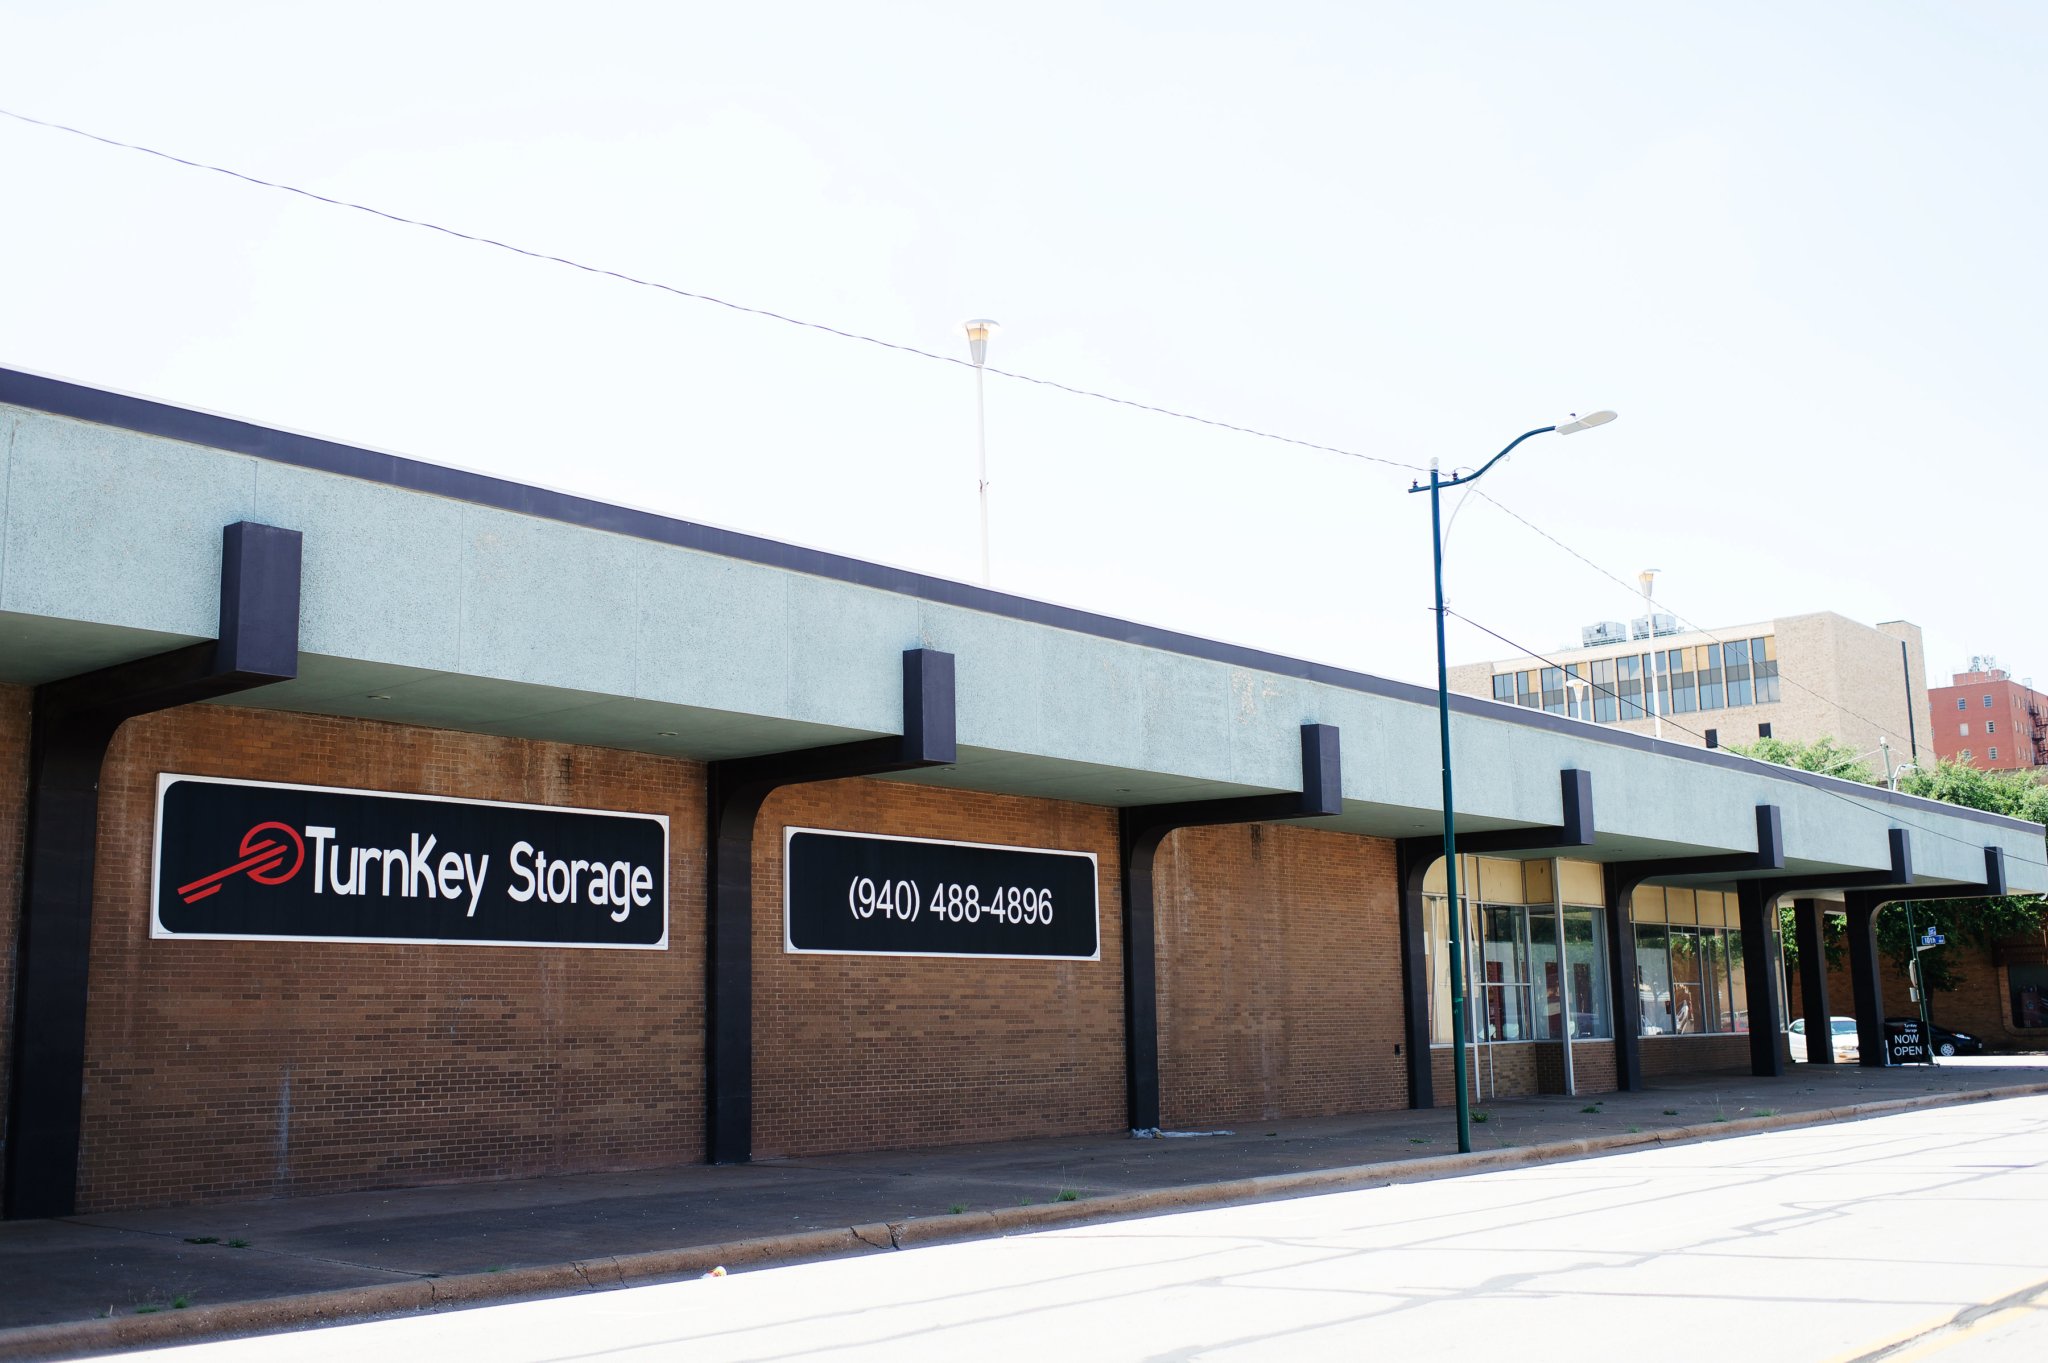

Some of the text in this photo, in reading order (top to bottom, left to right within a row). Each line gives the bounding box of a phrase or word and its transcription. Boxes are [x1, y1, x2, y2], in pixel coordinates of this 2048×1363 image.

[305, 825, 653, 923] TurnKey Storage
[848, 875, 1053, 925] (940) 488-4896
[1893, 1045, 1923, 1056] OPEN
[1894, 1034, 1919, 1044] NOW
